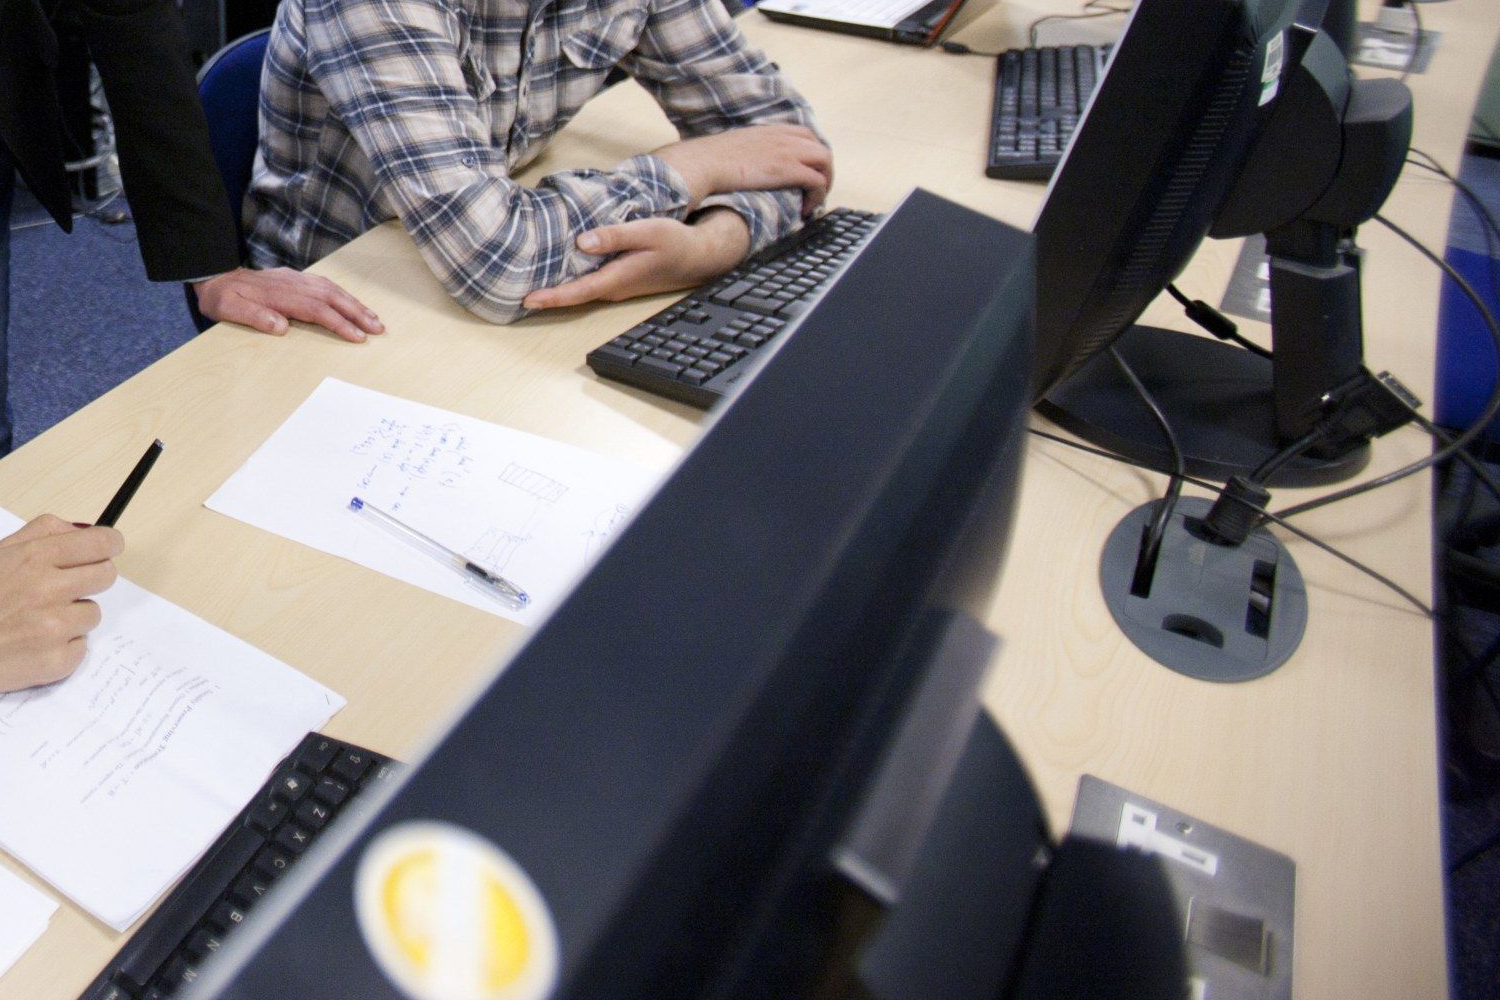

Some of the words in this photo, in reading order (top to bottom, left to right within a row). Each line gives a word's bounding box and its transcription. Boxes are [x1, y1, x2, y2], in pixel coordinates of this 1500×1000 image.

[312, 806, 327, 819] Z
[292, 831, 307, 844] X
[274, 859, 287, 870] C
[252, 884, 266, 897] V
[230, 911, 244, 924] B
[206, 938, 222, 952] N
[181, 967, 198, 984] M
